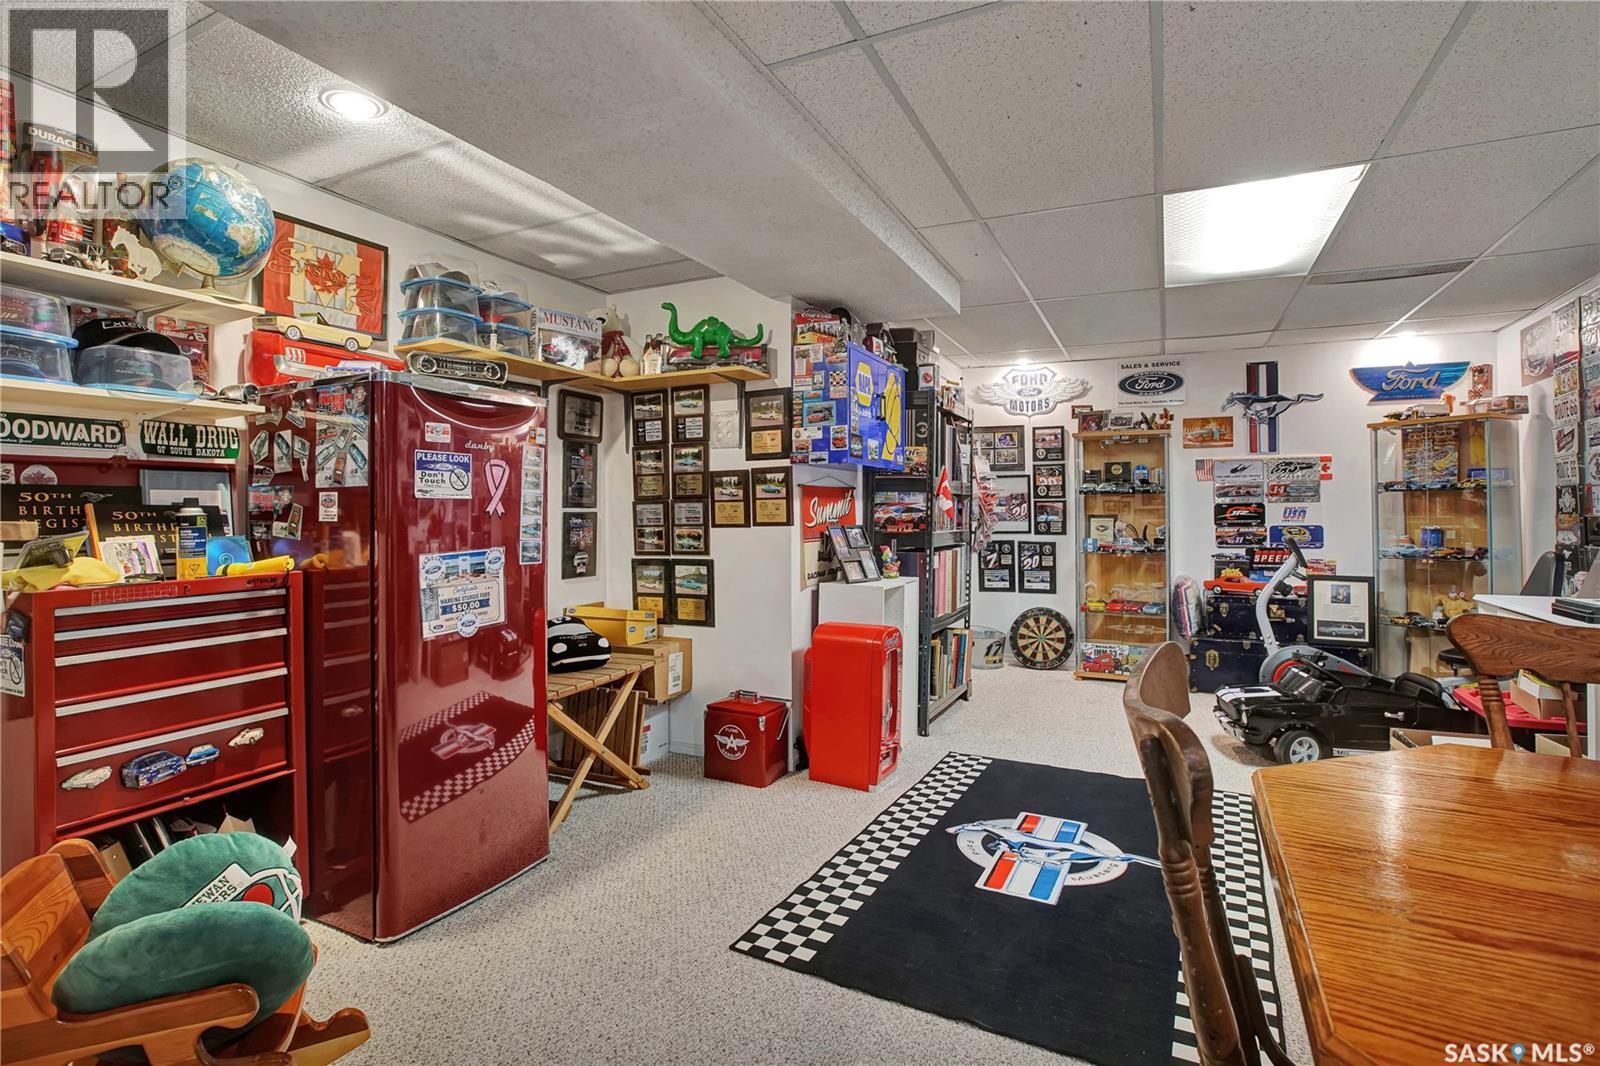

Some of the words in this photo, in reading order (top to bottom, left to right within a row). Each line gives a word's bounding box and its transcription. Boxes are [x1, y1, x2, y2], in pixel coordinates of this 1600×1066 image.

[543, 311, 599, 333] MUSTANG
[1011, 373, 1048, 386] FORD
[1135, 377, 1166, 389] Ford
[1382, 367, 1441, 391] Ford
[1009, 397, 1050, 412] MOTORS
[143, 420, 188, 447] WALL
[195, 425, 239, 449] DRUG
[157, 446, 167, 454] OF
[170, 447, 193, 455] SOUTH
[196, 448, 225, 457] DAKOTA
[464, 439, 496, 453] danby
[416, 452, 448, 462] PLEASE
[449, 455, 470, 464] LOOK
[420, 470, 445, 478] Don't
[419, 477, 446, 485] Touch
[1272, 485, 1285, 493] 14
[18, 492, 72, 502] 50TH
[19, 505, 81, 515] BIRTH
[804, 489, 852, 528] Summit
[112, 511, 157, 520] 50TH
[1023, 554, 1040, 570] 20
[452, 600, 480, 613] $50.00
[1071, 862, 1120, 882] Mustang
